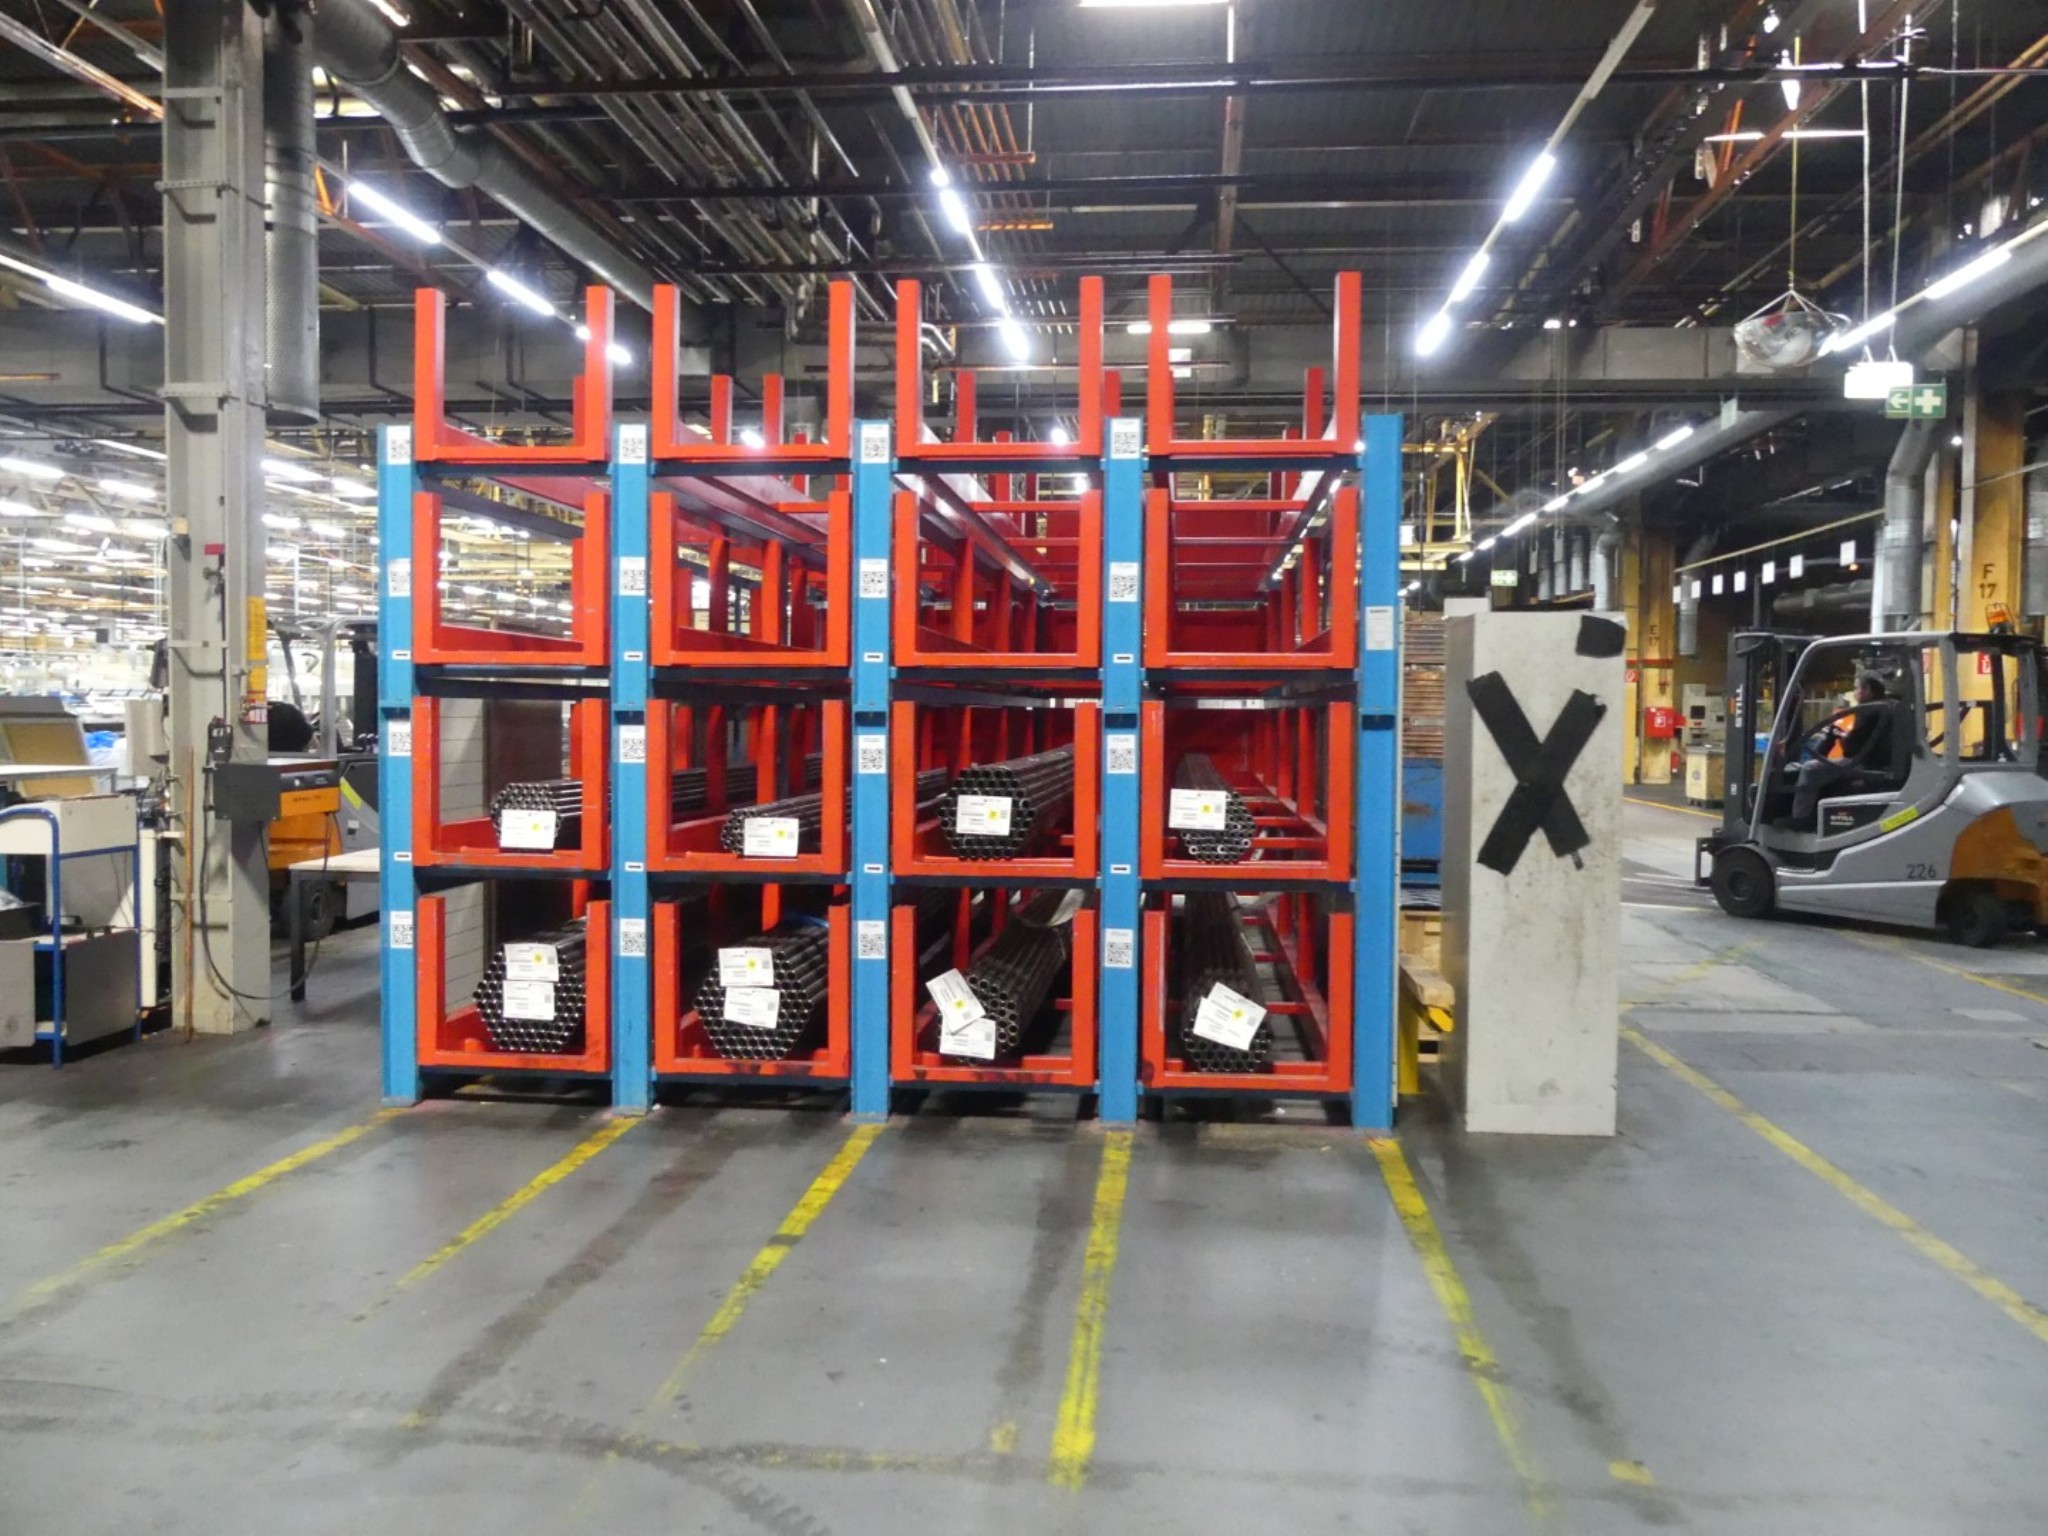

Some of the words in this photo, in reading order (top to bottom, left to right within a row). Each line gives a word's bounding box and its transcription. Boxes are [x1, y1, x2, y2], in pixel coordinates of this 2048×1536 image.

[1983, 564, 1995, 579] F
[1979, 583, 1997, 599] 17
[1735, 683, 1743, 728] STILL
[1907, 864, 1937, 880] 226
